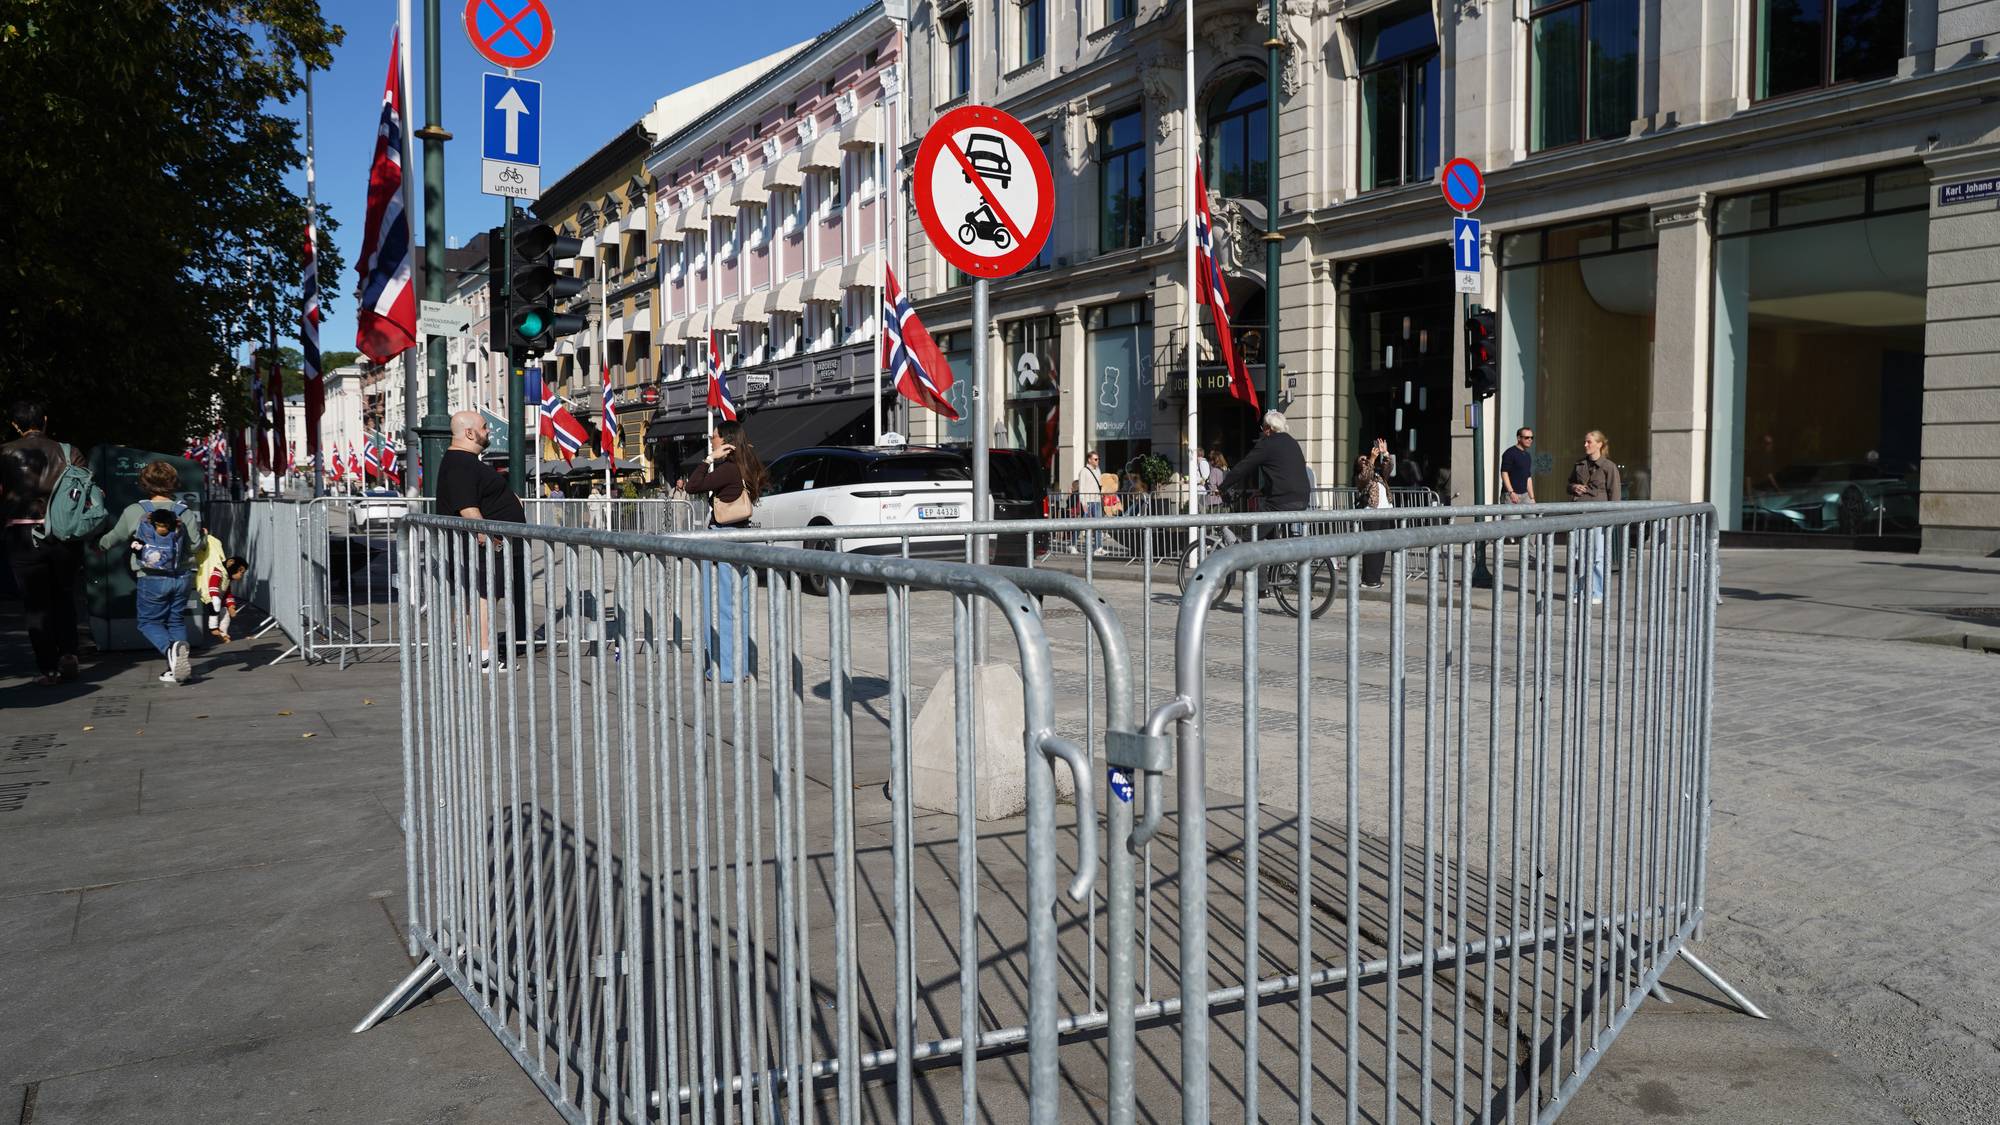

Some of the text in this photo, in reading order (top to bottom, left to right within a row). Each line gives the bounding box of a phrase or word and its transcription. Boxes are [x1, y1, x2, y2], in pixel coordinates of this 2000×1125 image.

[495, 185, 527, 195] unntatt
[1946, 185, 1961, 196] Karl
[1965, 182, 1993, 193] Johans
[1174, 377, 1201, 390] JOHN
[925, 508, 958, 516] EP 44328
